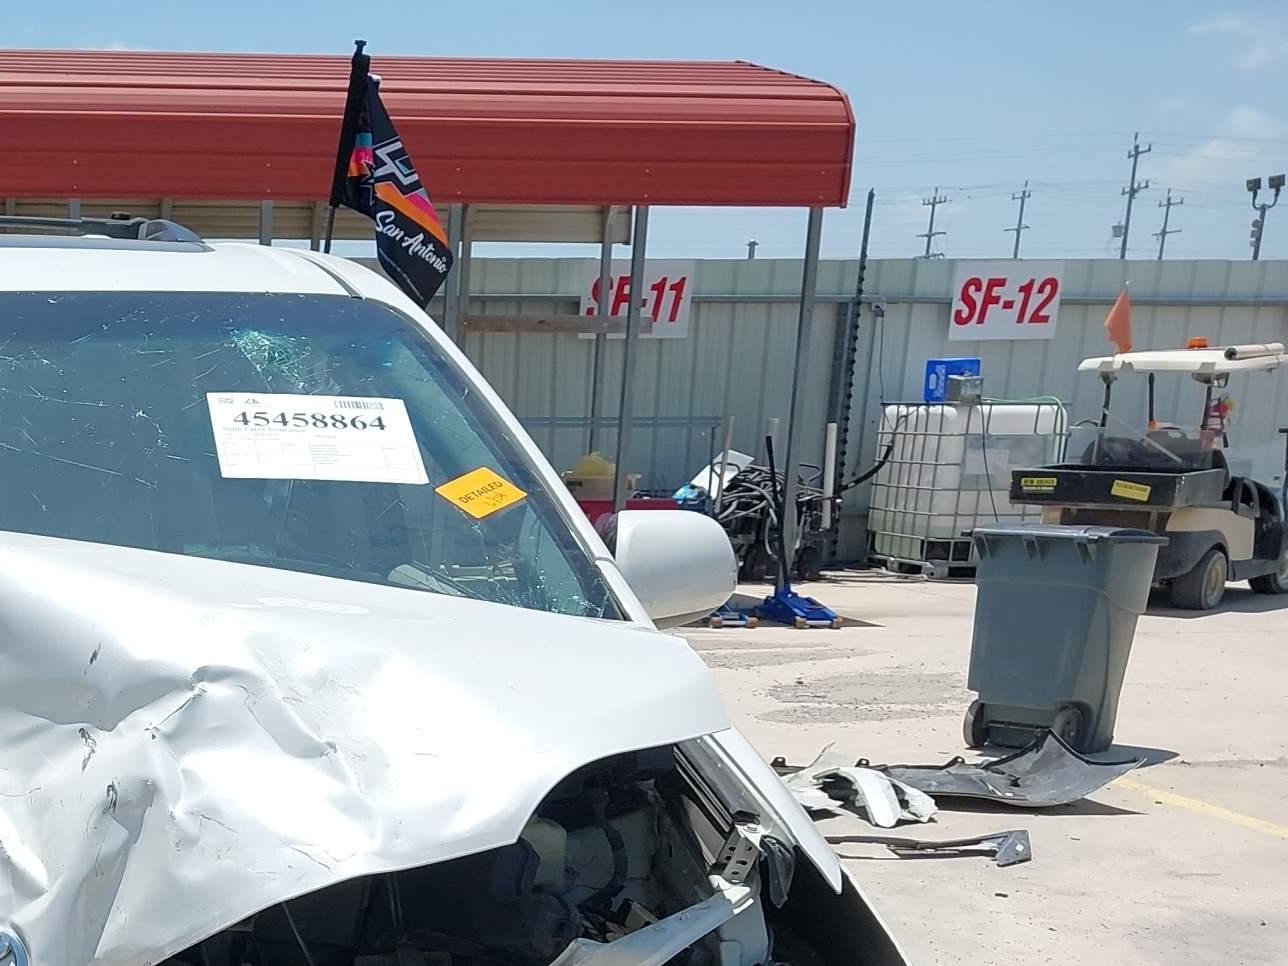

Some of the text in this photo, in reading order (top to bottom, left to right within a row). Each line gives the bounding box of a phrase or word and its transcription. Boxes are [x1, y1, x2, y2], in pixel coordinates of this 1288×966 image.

[375, 210, 405, 241] San
[401, 232, 448, 274] Antonio
[953, 276, 1060, 326] SF-12
[233, 410, 387, 431] 45458864
[458, 480, 504, 504] DETAILED
